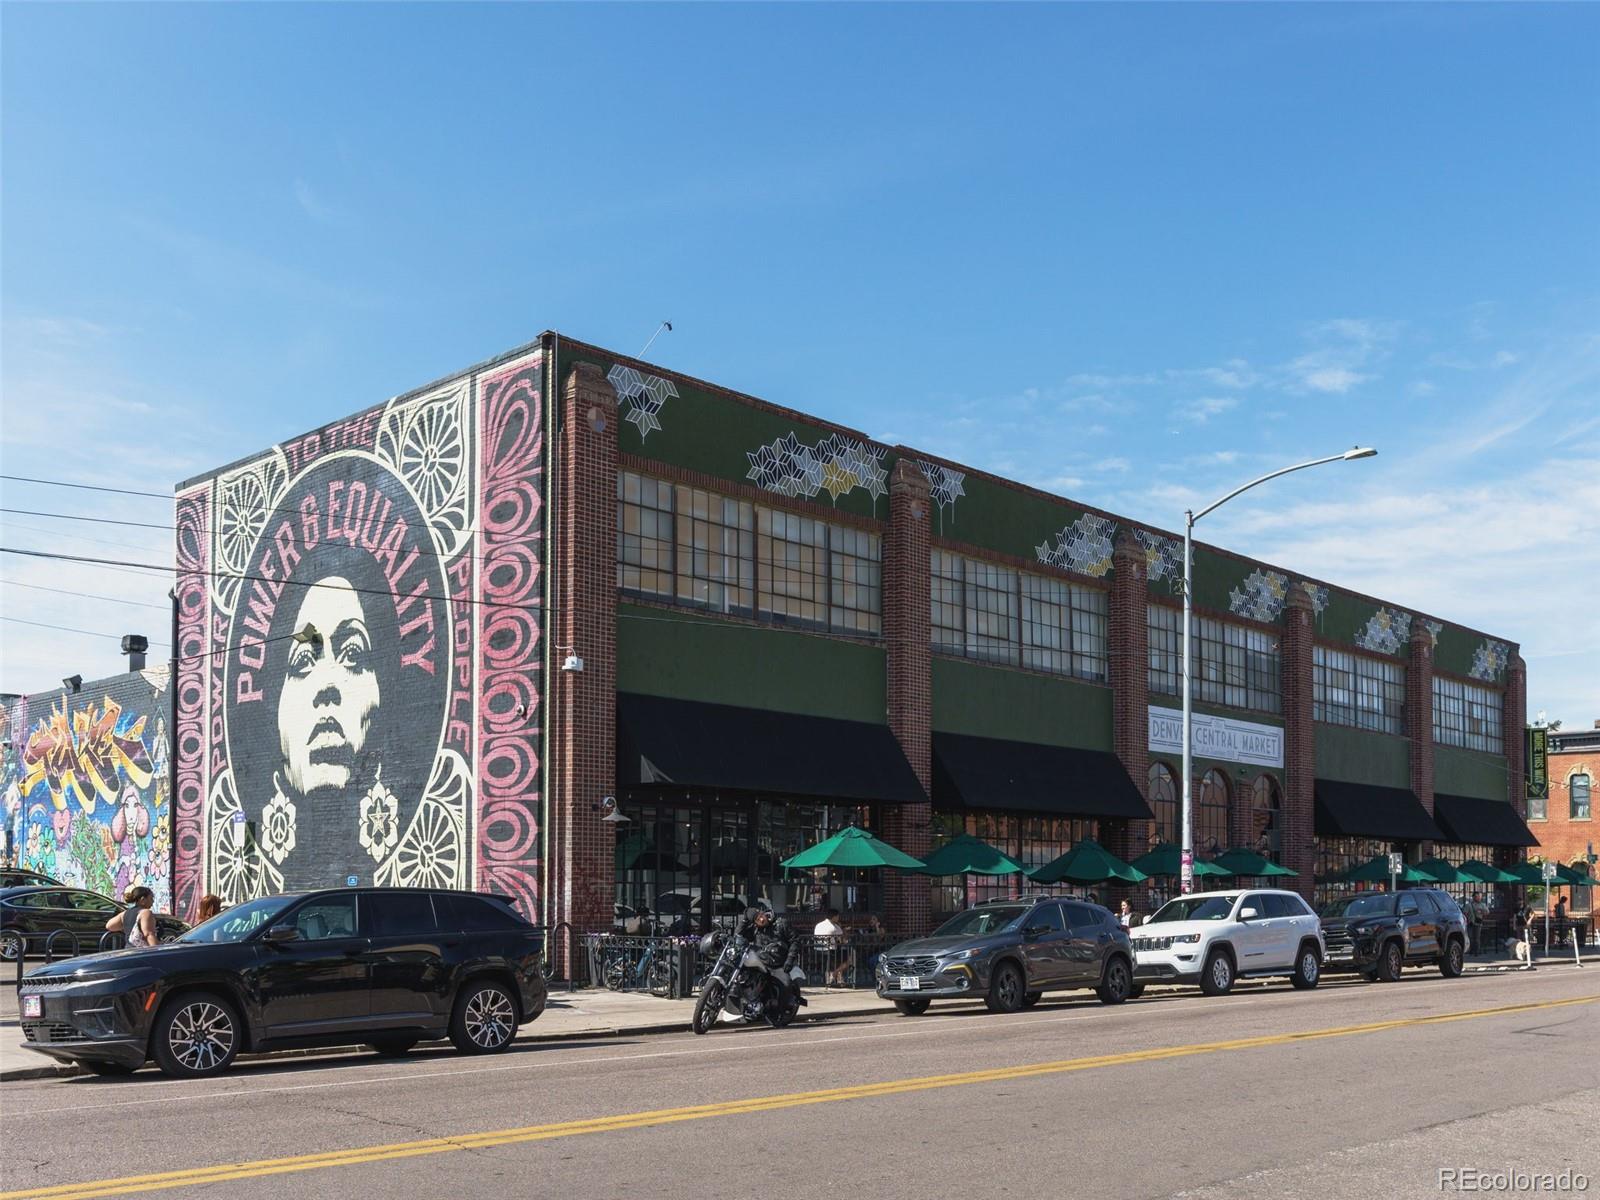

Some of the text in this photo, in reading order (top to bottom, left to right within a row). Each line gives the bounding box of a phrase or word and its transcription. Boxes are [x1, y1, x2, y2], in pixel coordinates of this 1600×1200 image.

[211, 409, 471, 779] POWER TO THE PEOPLE
[236, 521, 302, 704] POWER
[326, 480, 435, 675] EQUALITY
[1195, 727, 1238, 749] CENTRAL
[1242, 736, 1277, 756] MARKET
[1535, 752, 1545, 768] THIS
[1535, 769, 1545, 784] WAY
